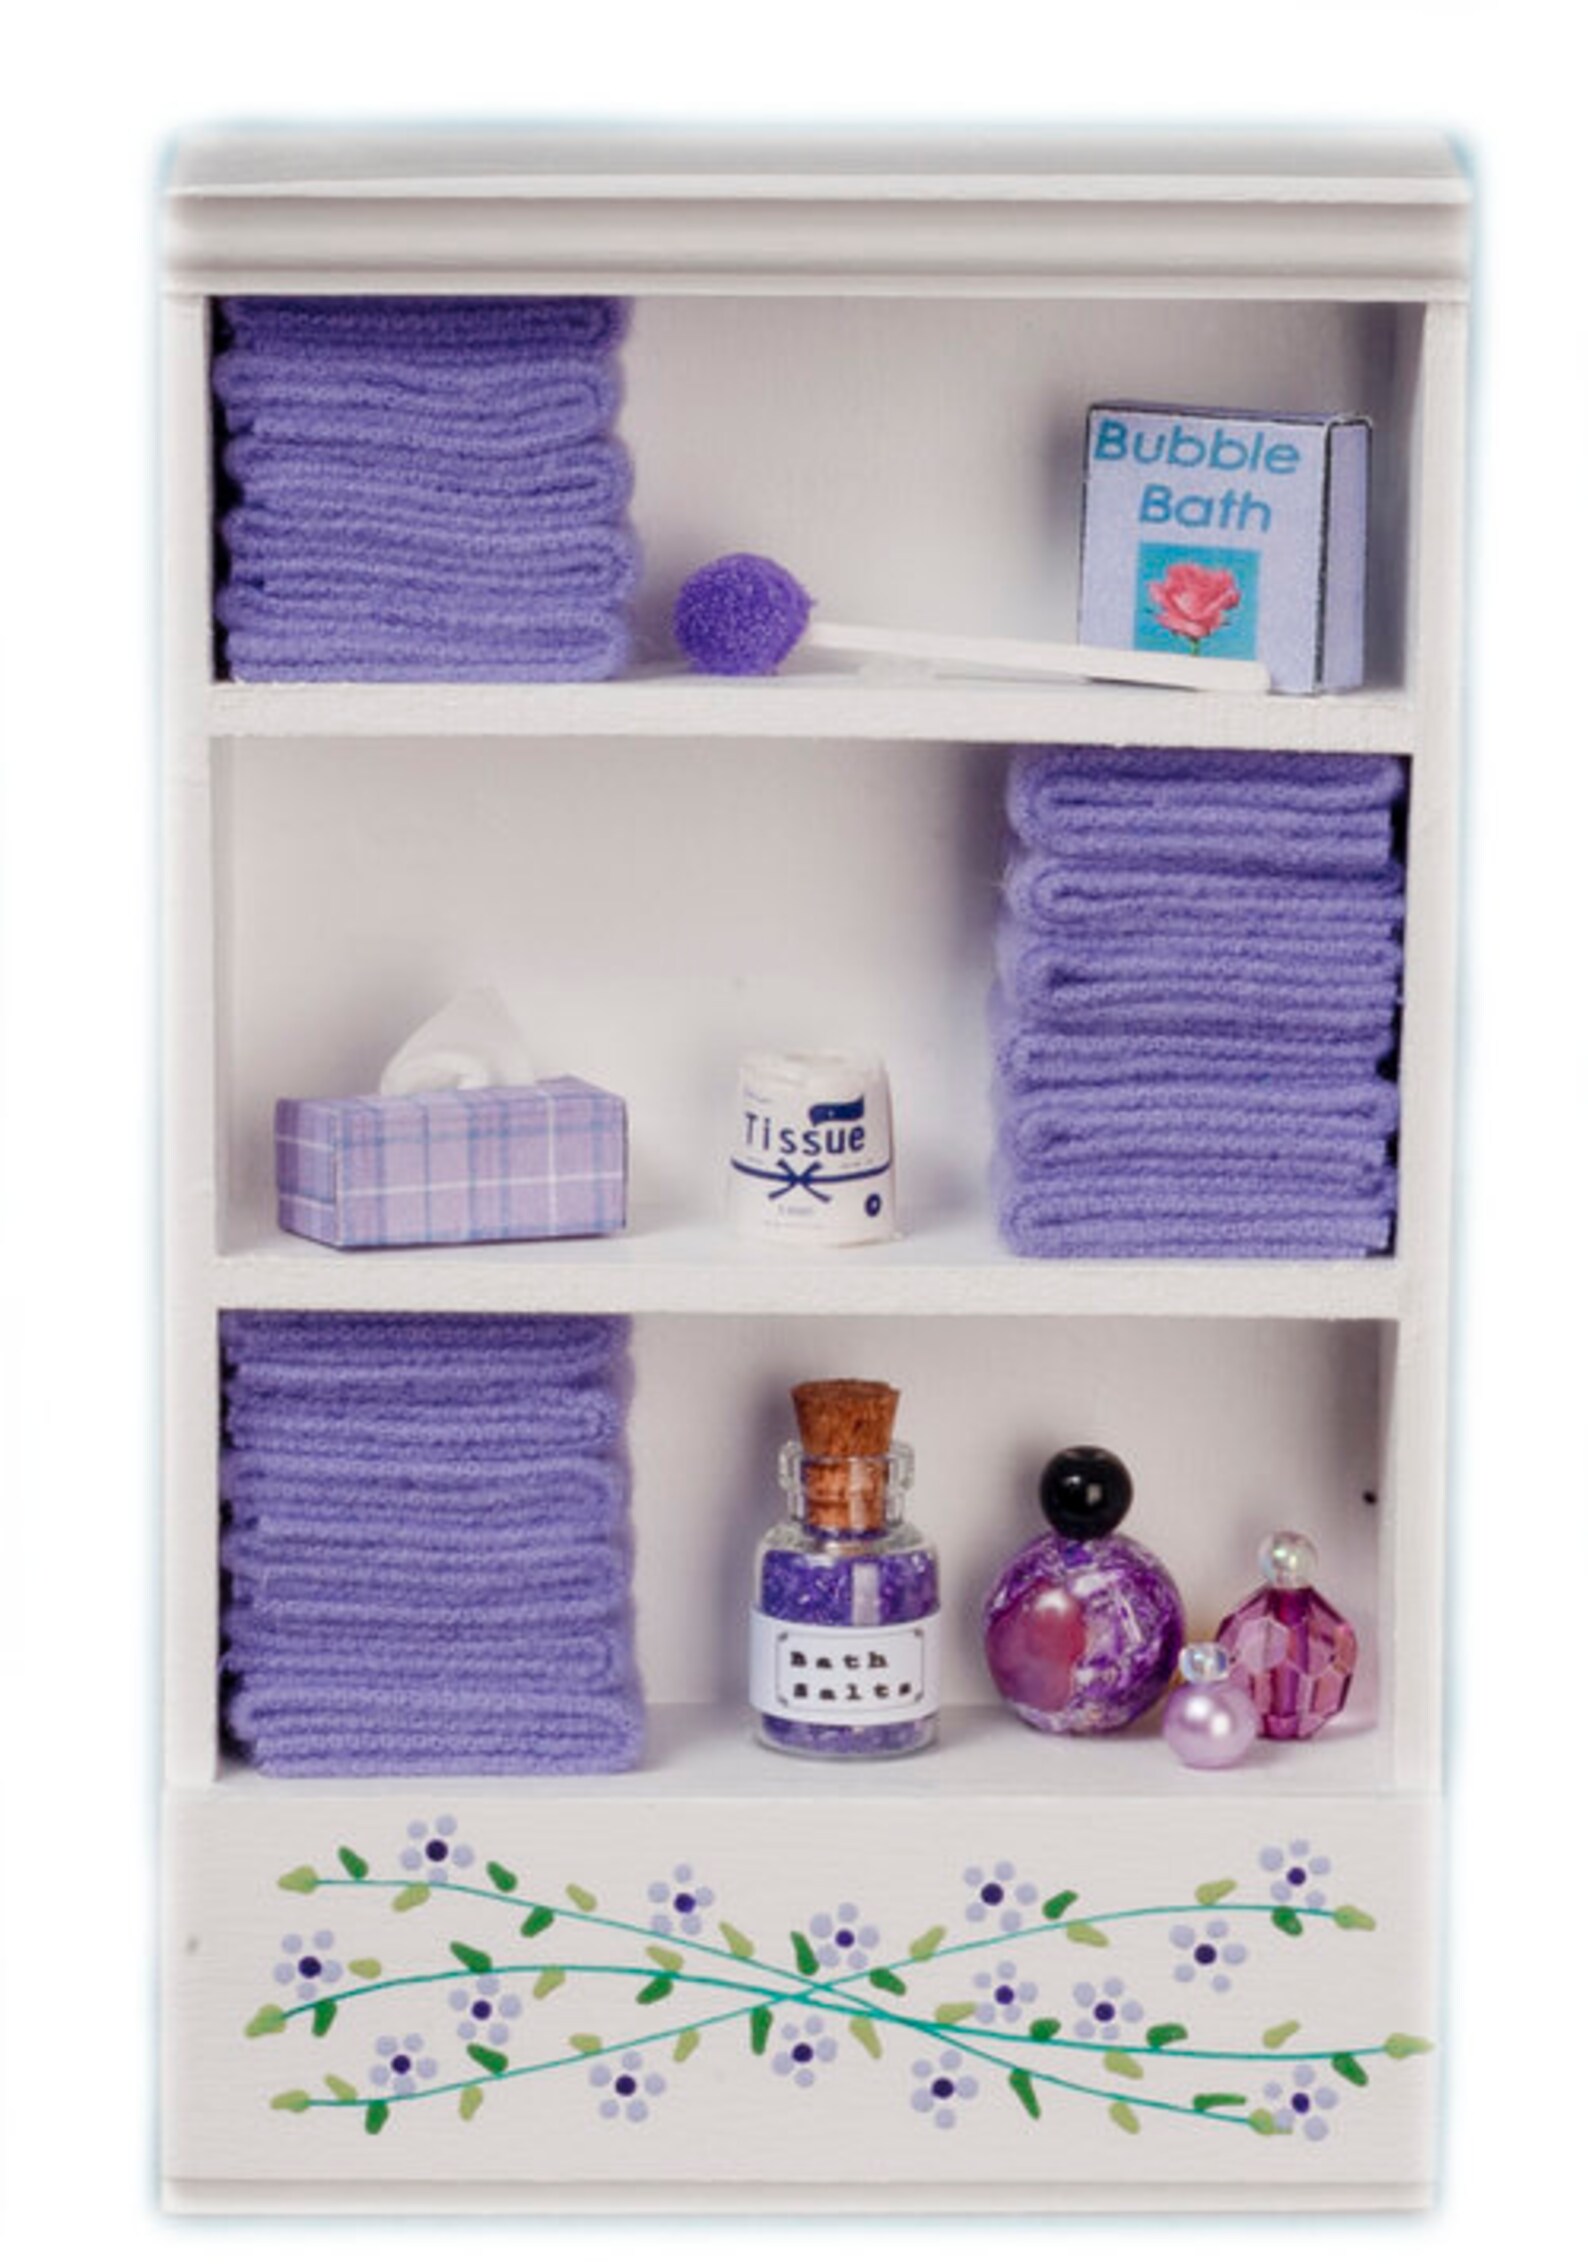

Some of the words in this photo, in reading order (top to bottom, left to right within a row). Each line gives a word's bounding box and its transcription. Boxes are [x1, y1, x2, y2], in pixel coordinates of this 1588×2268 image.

[1093, 419, 1301, 475] Bubble
[1138, 483, 1273, 533] Bath
[745, 1111, 865, 1156] Tissue
[789, 1650, 889, 1670] Bath
